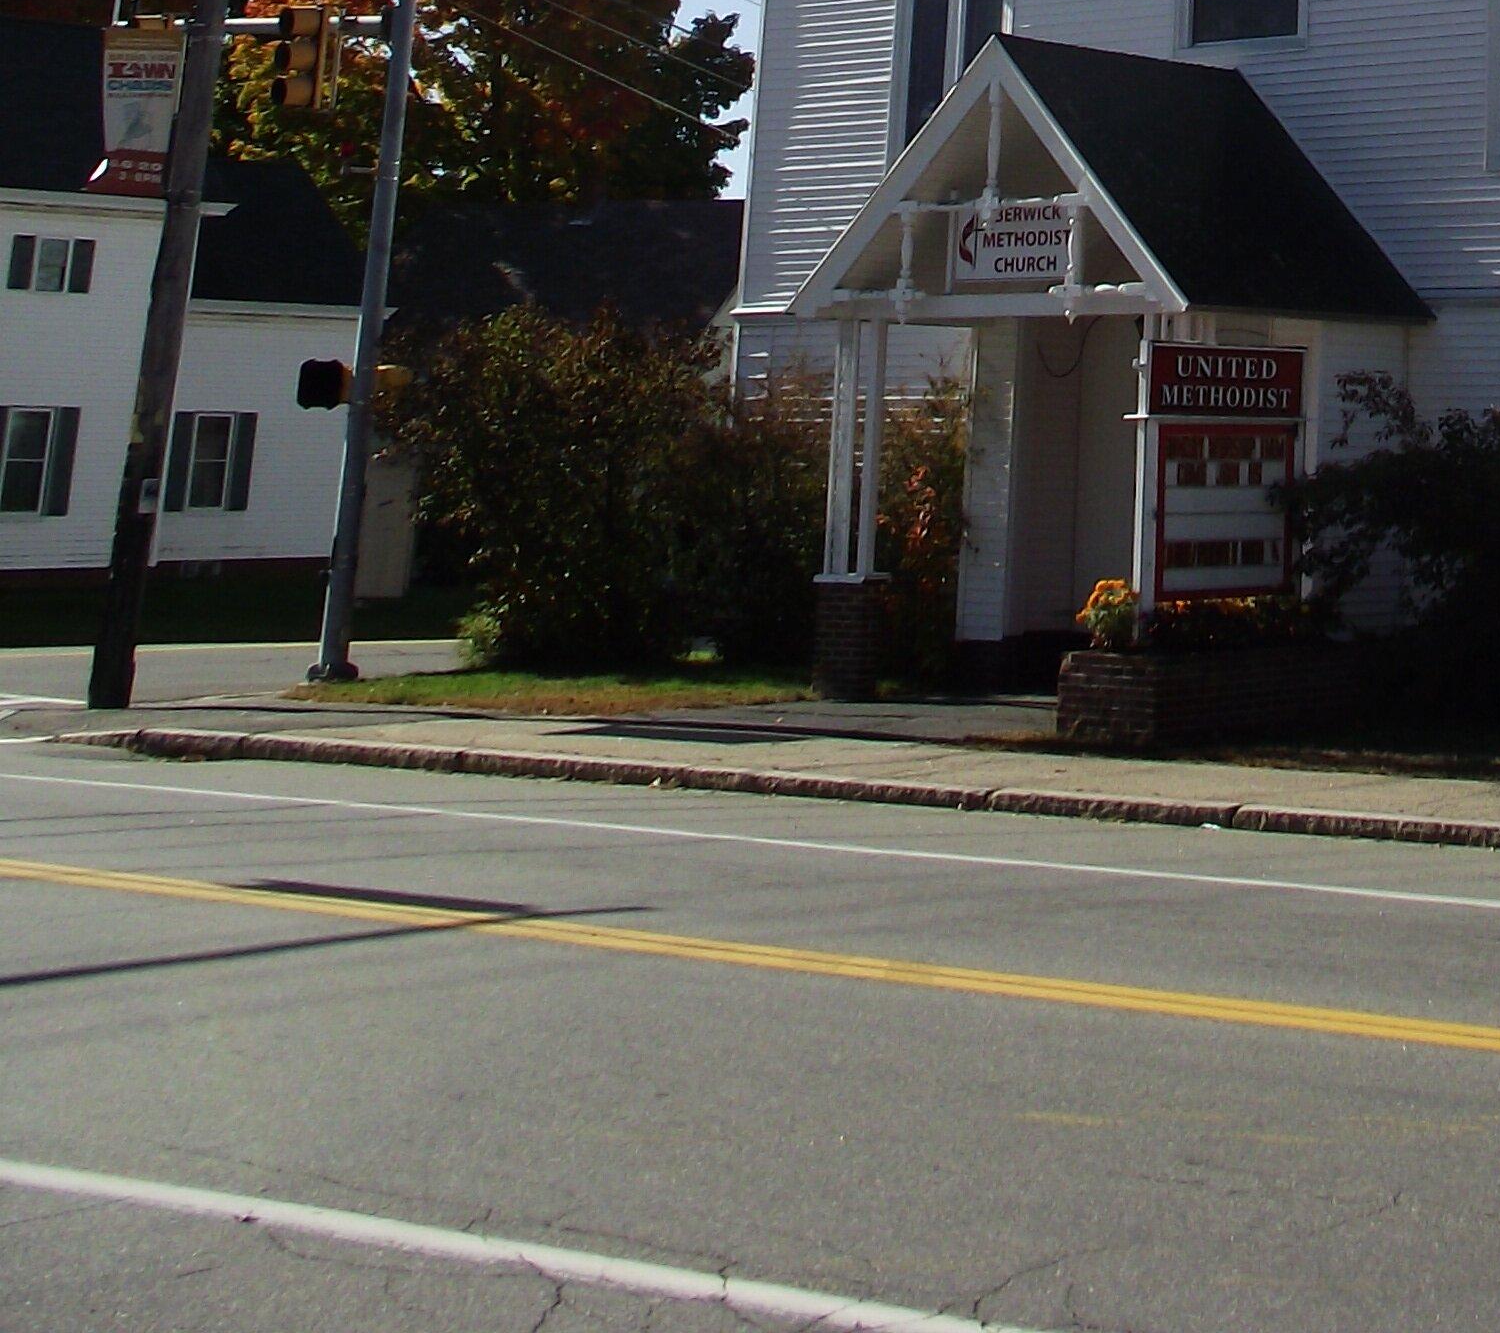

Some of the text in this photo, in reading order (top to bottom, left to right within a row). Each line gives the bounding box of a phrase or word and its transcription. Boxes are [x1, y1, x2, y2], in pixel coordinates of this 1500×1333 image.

[983, 229, 1071, 248] METHODIST
[994, 255, 1057, 273] CHURCH
[1177, 355, 1278, 379] UNITED
[1161, 384, 1292, 409] METHODIST
